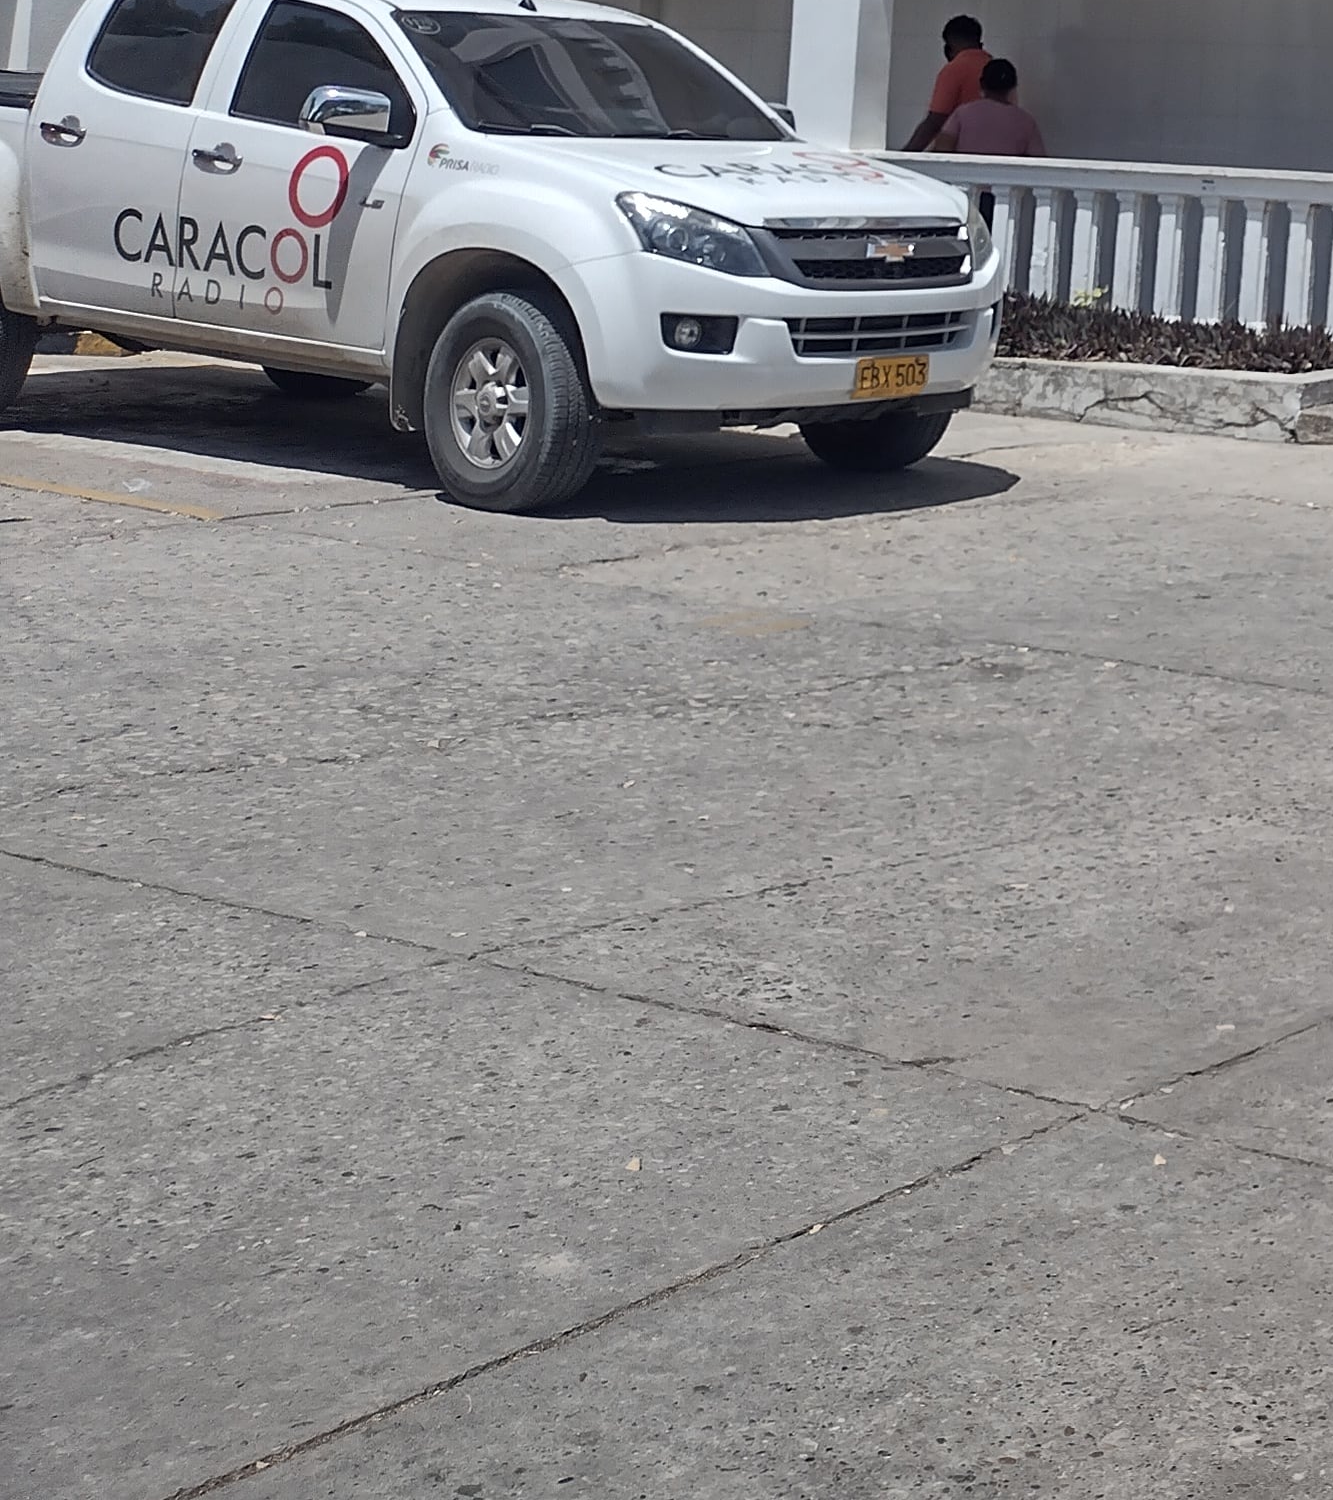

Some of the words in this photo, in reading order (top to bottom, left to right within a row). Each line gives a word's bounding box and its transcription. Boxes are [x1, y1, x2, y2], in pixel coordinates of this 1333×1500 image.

[439, 158, 469, 171] PRISA
[114, 208, 332, 289] CARACOL
[151, 272, 284, 315] RADIO
[860, 365, 892, 390] EBX
[896, 362, 927, 388] 503
